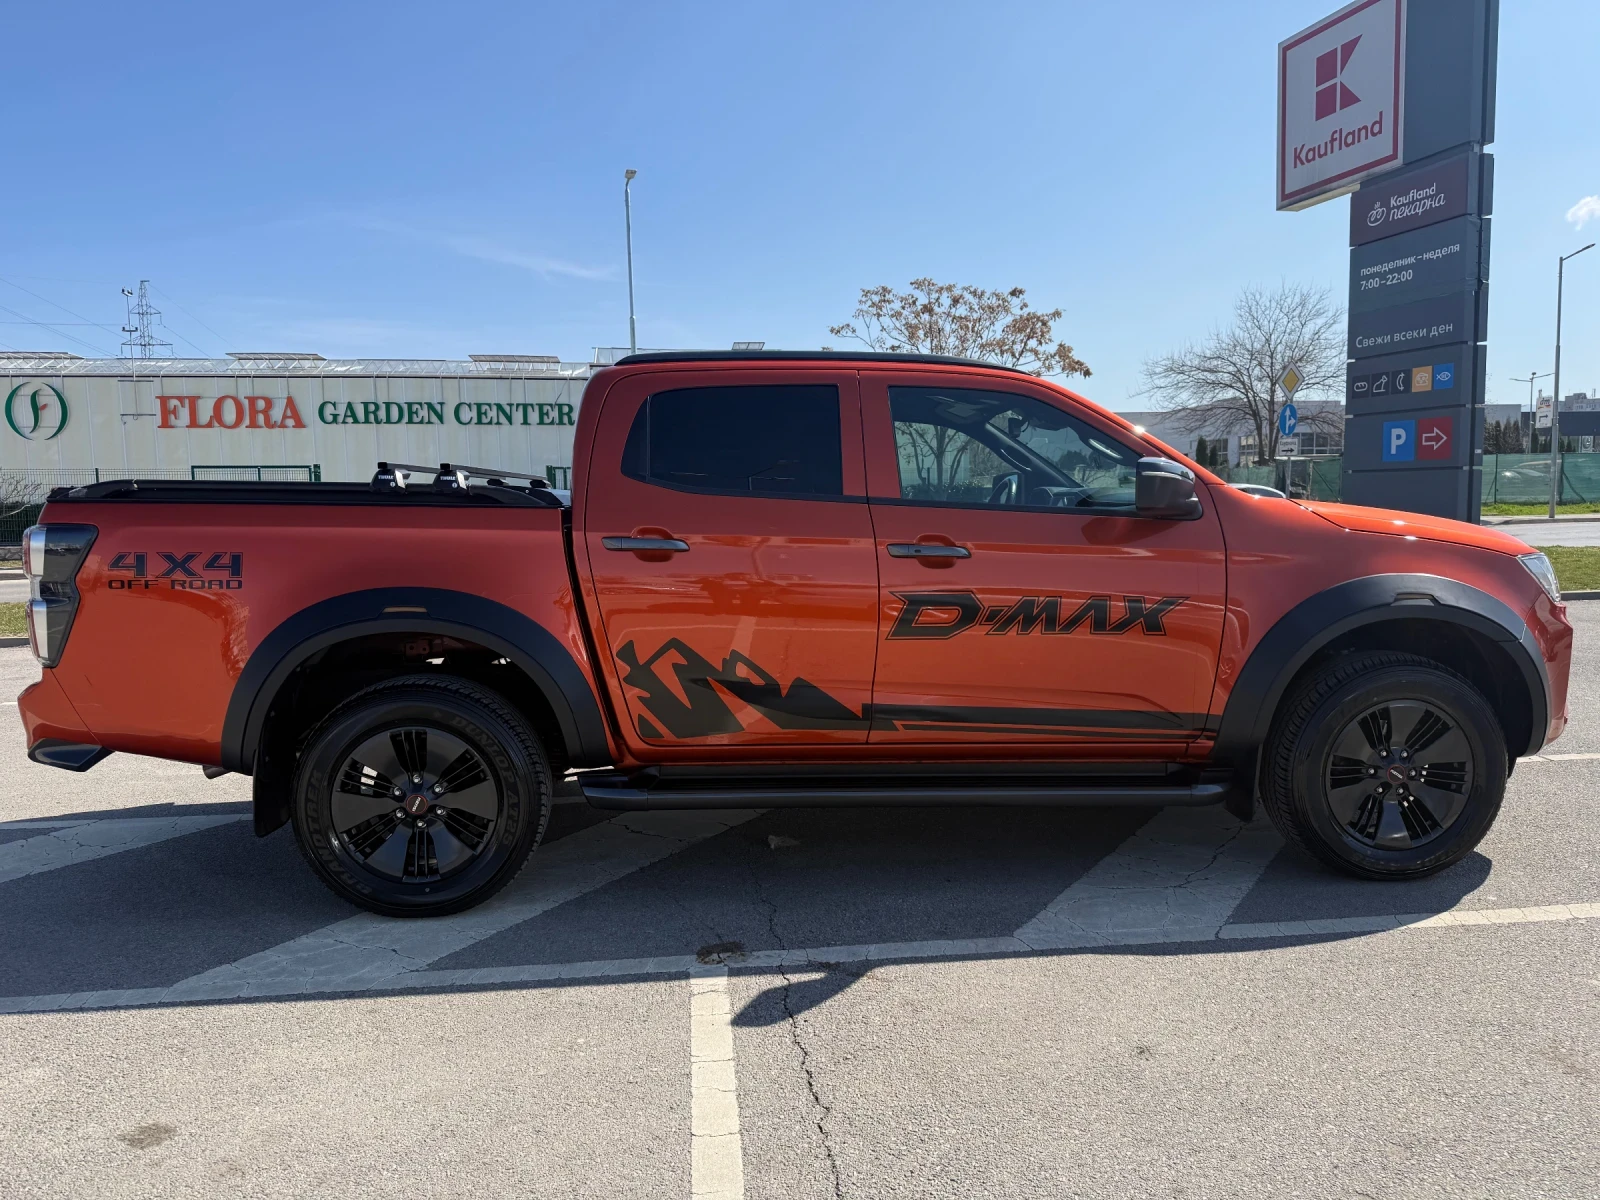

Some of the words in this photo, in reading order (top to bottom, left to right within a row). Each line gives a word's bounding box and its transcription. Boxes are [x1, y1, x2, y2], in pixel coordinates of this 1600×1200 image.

[1293, 111, 1383, 169] Kaufland
[1389, 193, 1446, 221] пекарна
[1390, 183, 1436, 208] Kaufland
[1355, 333, 1391, 348] Свежи
[1393, 328, 1427, 342] всеки
[1429, 323, 1453, 338] ден
[155, 395, 307, 429] FLORA
[318, 401, 445, 425] GARDEN
[453, 402, 575, 426] CENTER
[1390, 428, 1406, 454] P
[108, 579, 159, 589] OFF
[170, 579, 243, 590] ROAD
[885, 590, 1191, 640] D-MAX
[451, 716, 515, 783] DUNLOP
[502, 790, 520, 845] AT25
